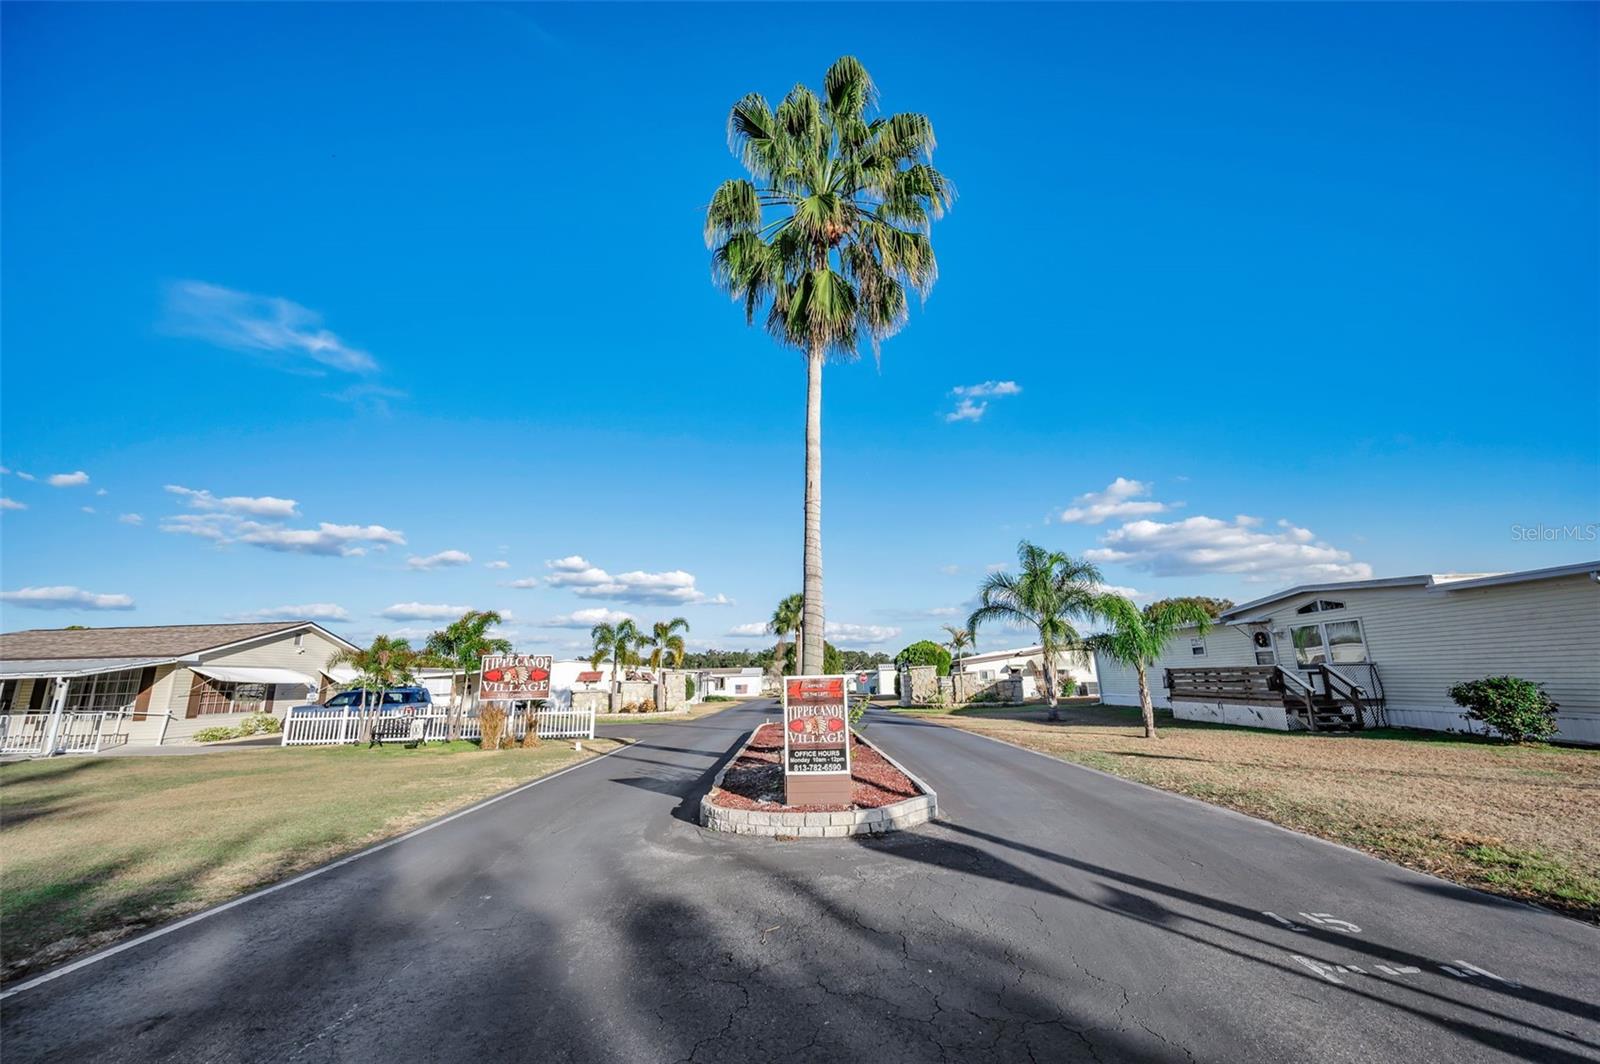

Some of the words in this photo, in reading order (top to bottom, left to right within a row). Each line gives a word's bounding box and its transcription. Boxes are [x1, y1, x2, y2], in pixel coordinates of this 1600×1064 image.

[484, 657, 550, 672] TIPPECANOE
[482, 680, 549, 692] VILLAGE
[787, 704, 844, 720] TIPPECANOE
[788, 730, 845, 744] VILLAGE
[794, 750, 817, 758] OFFICE
